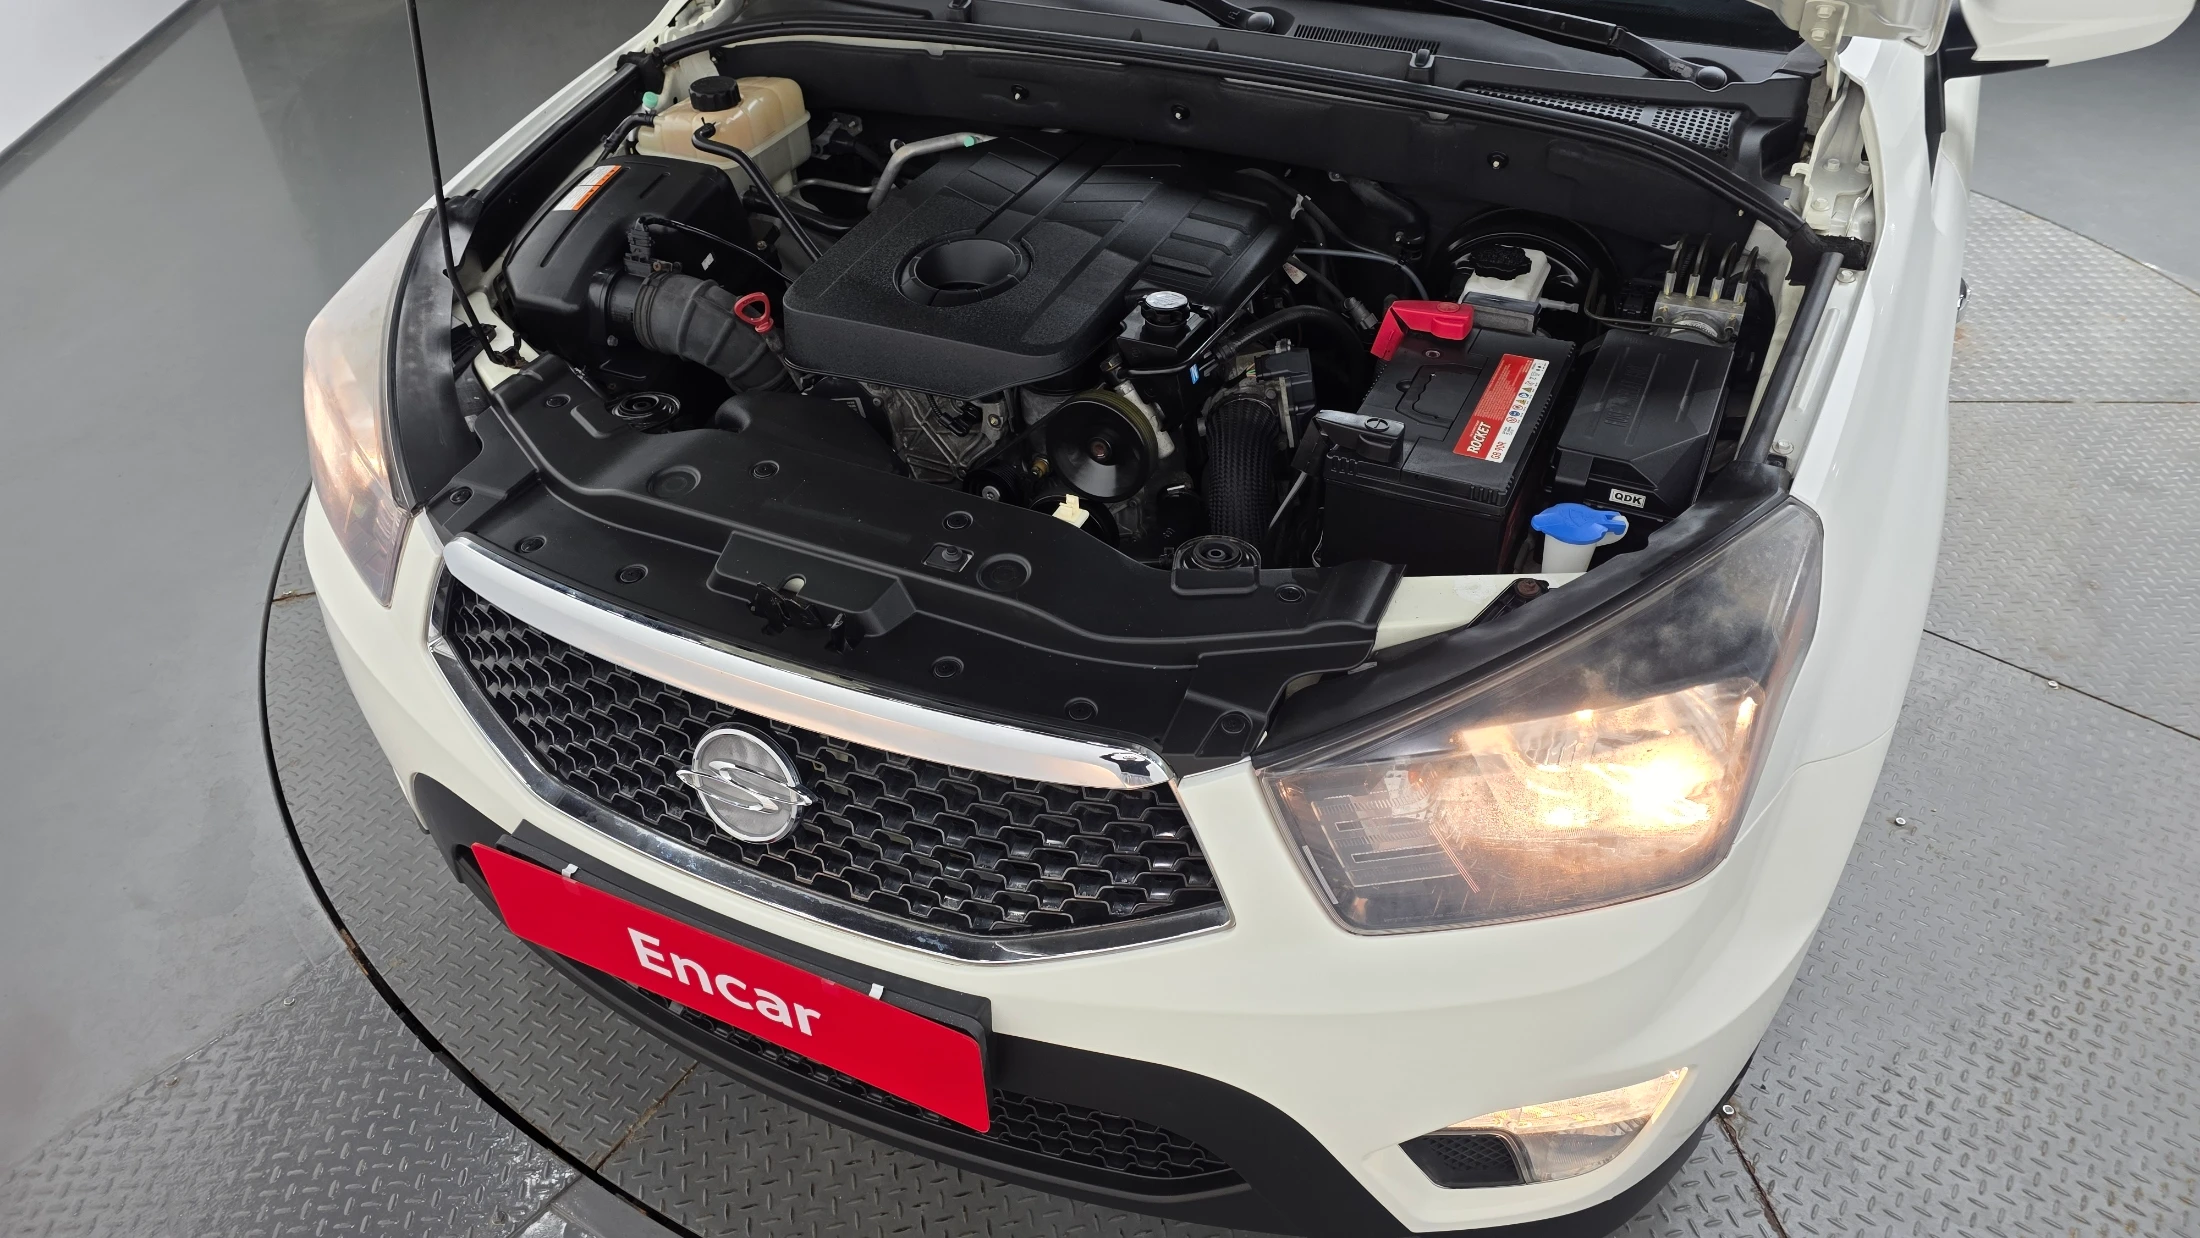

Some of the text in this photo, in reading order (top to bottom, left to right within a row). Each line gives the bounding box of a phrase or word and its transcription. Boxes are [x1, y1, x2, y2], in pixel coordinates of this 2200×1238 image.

[1467, 421, 1491, 454] ROCKET
[1615, 493, 1642, 505] QDK
[627, 927, 822, 1036] Encar
